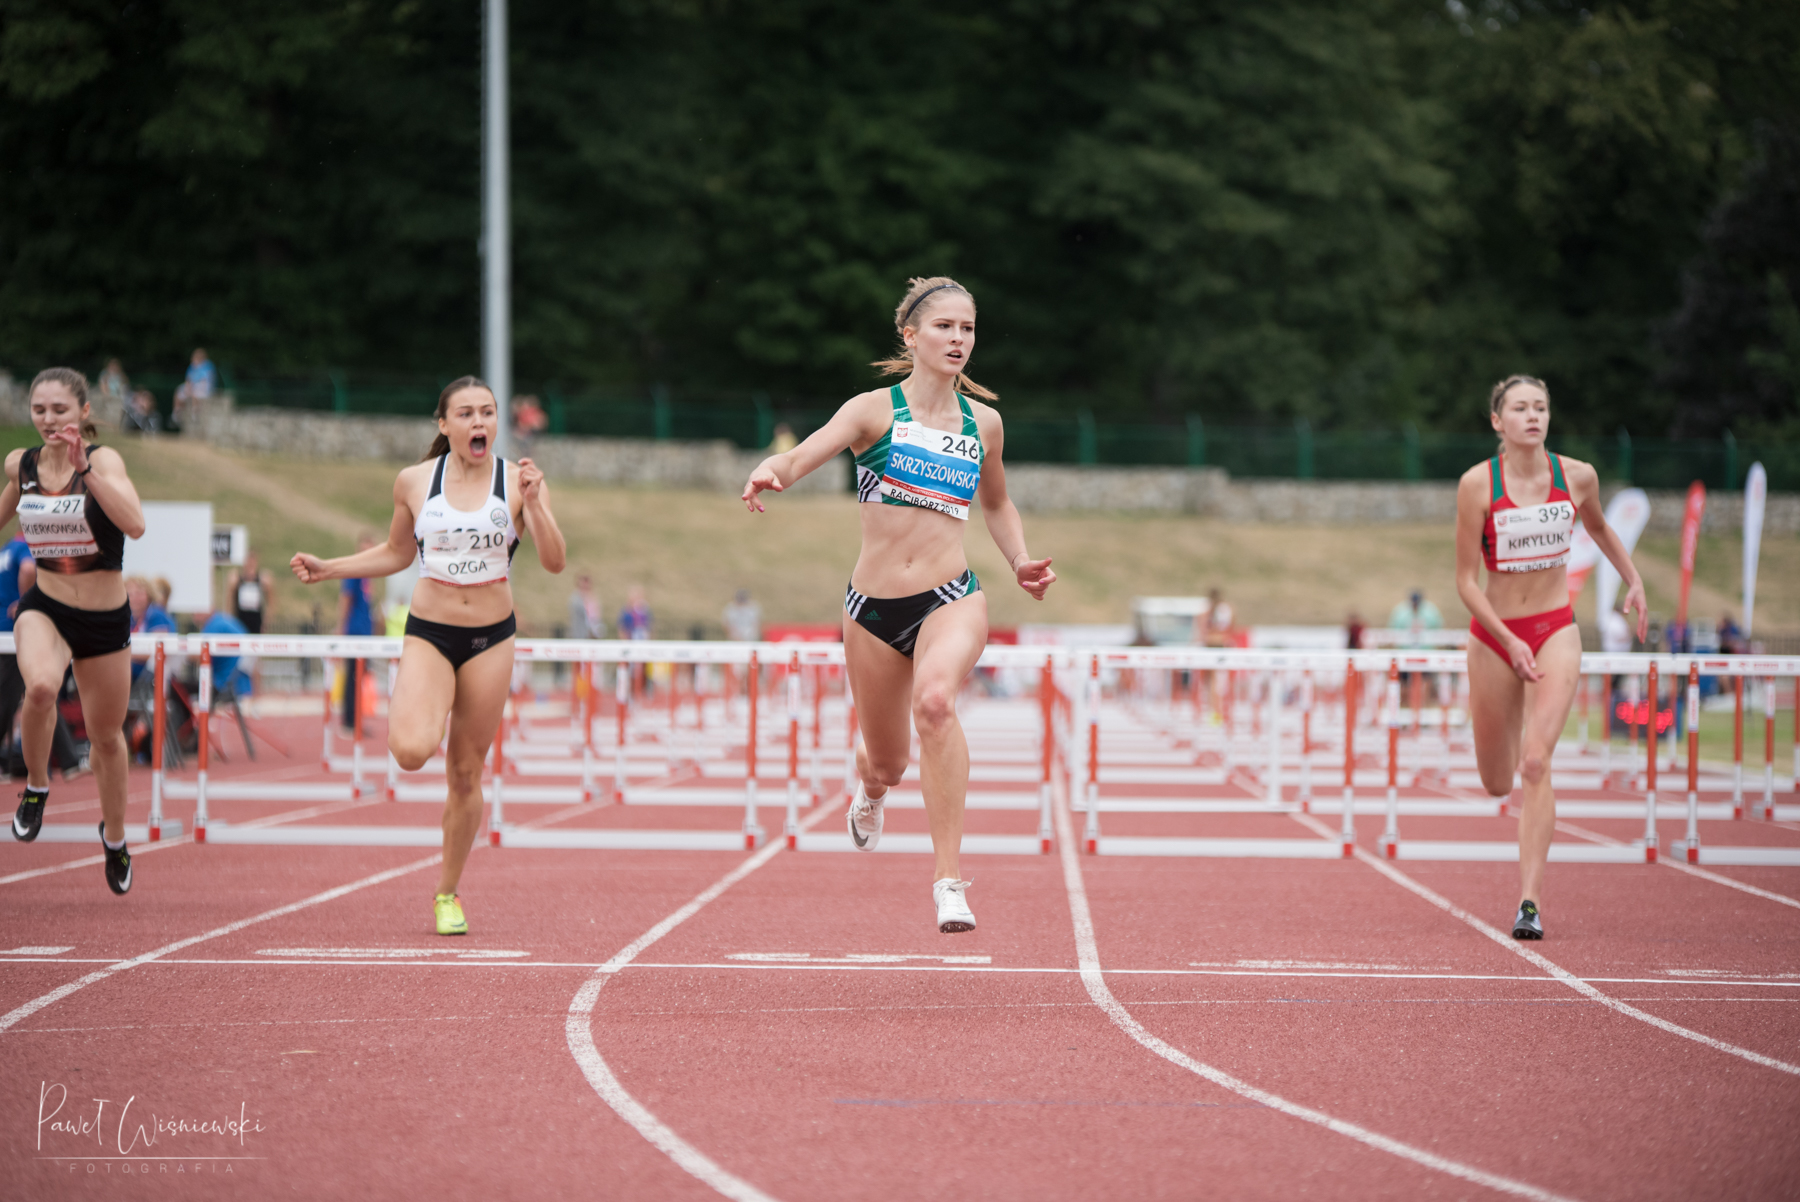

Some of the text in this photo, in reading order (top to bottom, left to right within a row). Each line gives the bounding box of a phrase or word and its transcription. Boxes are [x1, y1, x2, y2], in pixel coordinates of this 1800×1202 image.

[941, 435, 979, 460] 246
[890, 454, 976, 491] SKRZYSZOWSKA
[51, 499, 80, 514] 297
[890, 488, 959, 516] RACIBÓRZ 2019
[1538, 505, 1570, 523] 395
[470, 532, 504, 550] 210
[1508, 532, 1565, 550] KIRYLUK
[32, 547, 68, 556] RACIBÓRZ
[448, 560, 488, 576] OZGA
